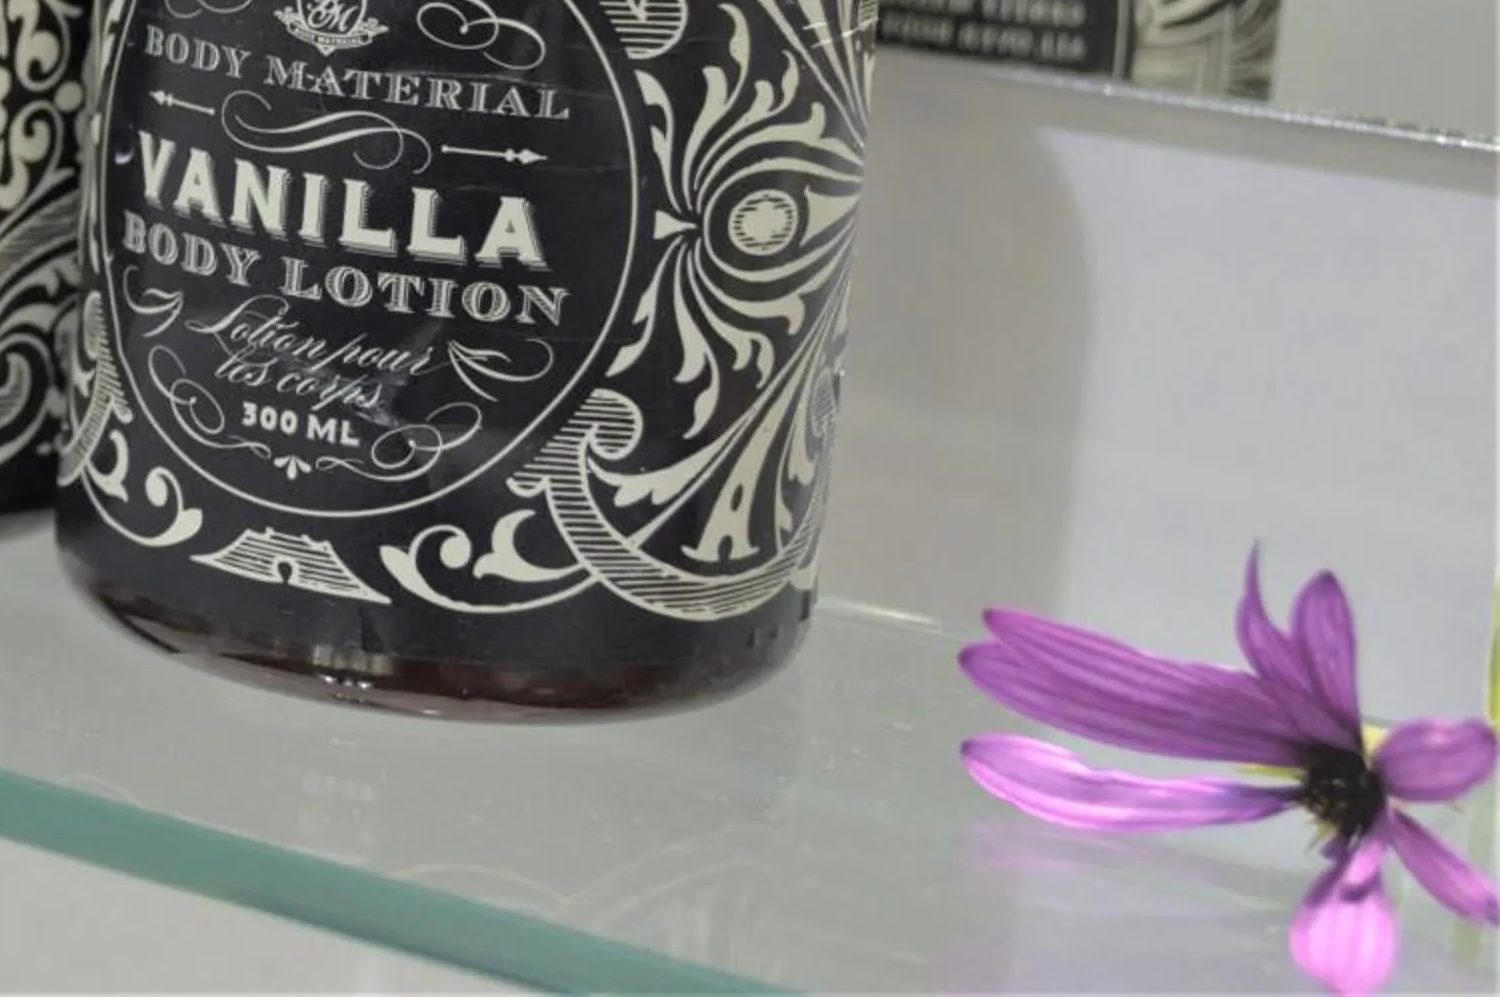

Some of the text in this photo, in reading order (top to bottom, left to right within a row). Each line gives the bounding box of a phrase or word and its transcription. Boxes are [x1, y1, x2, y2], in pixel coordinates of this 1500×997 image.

[145, 24, 571, 121] BODY MATERIAL
[137, 129, 549, 272] VANILLA
[123, 209, 571, 327] BODY LOTION
[185, 294, 436, 376] Lotion pour
[241, 400, 361, 447] 300 ML
[275, 374, 385, 412] corps
